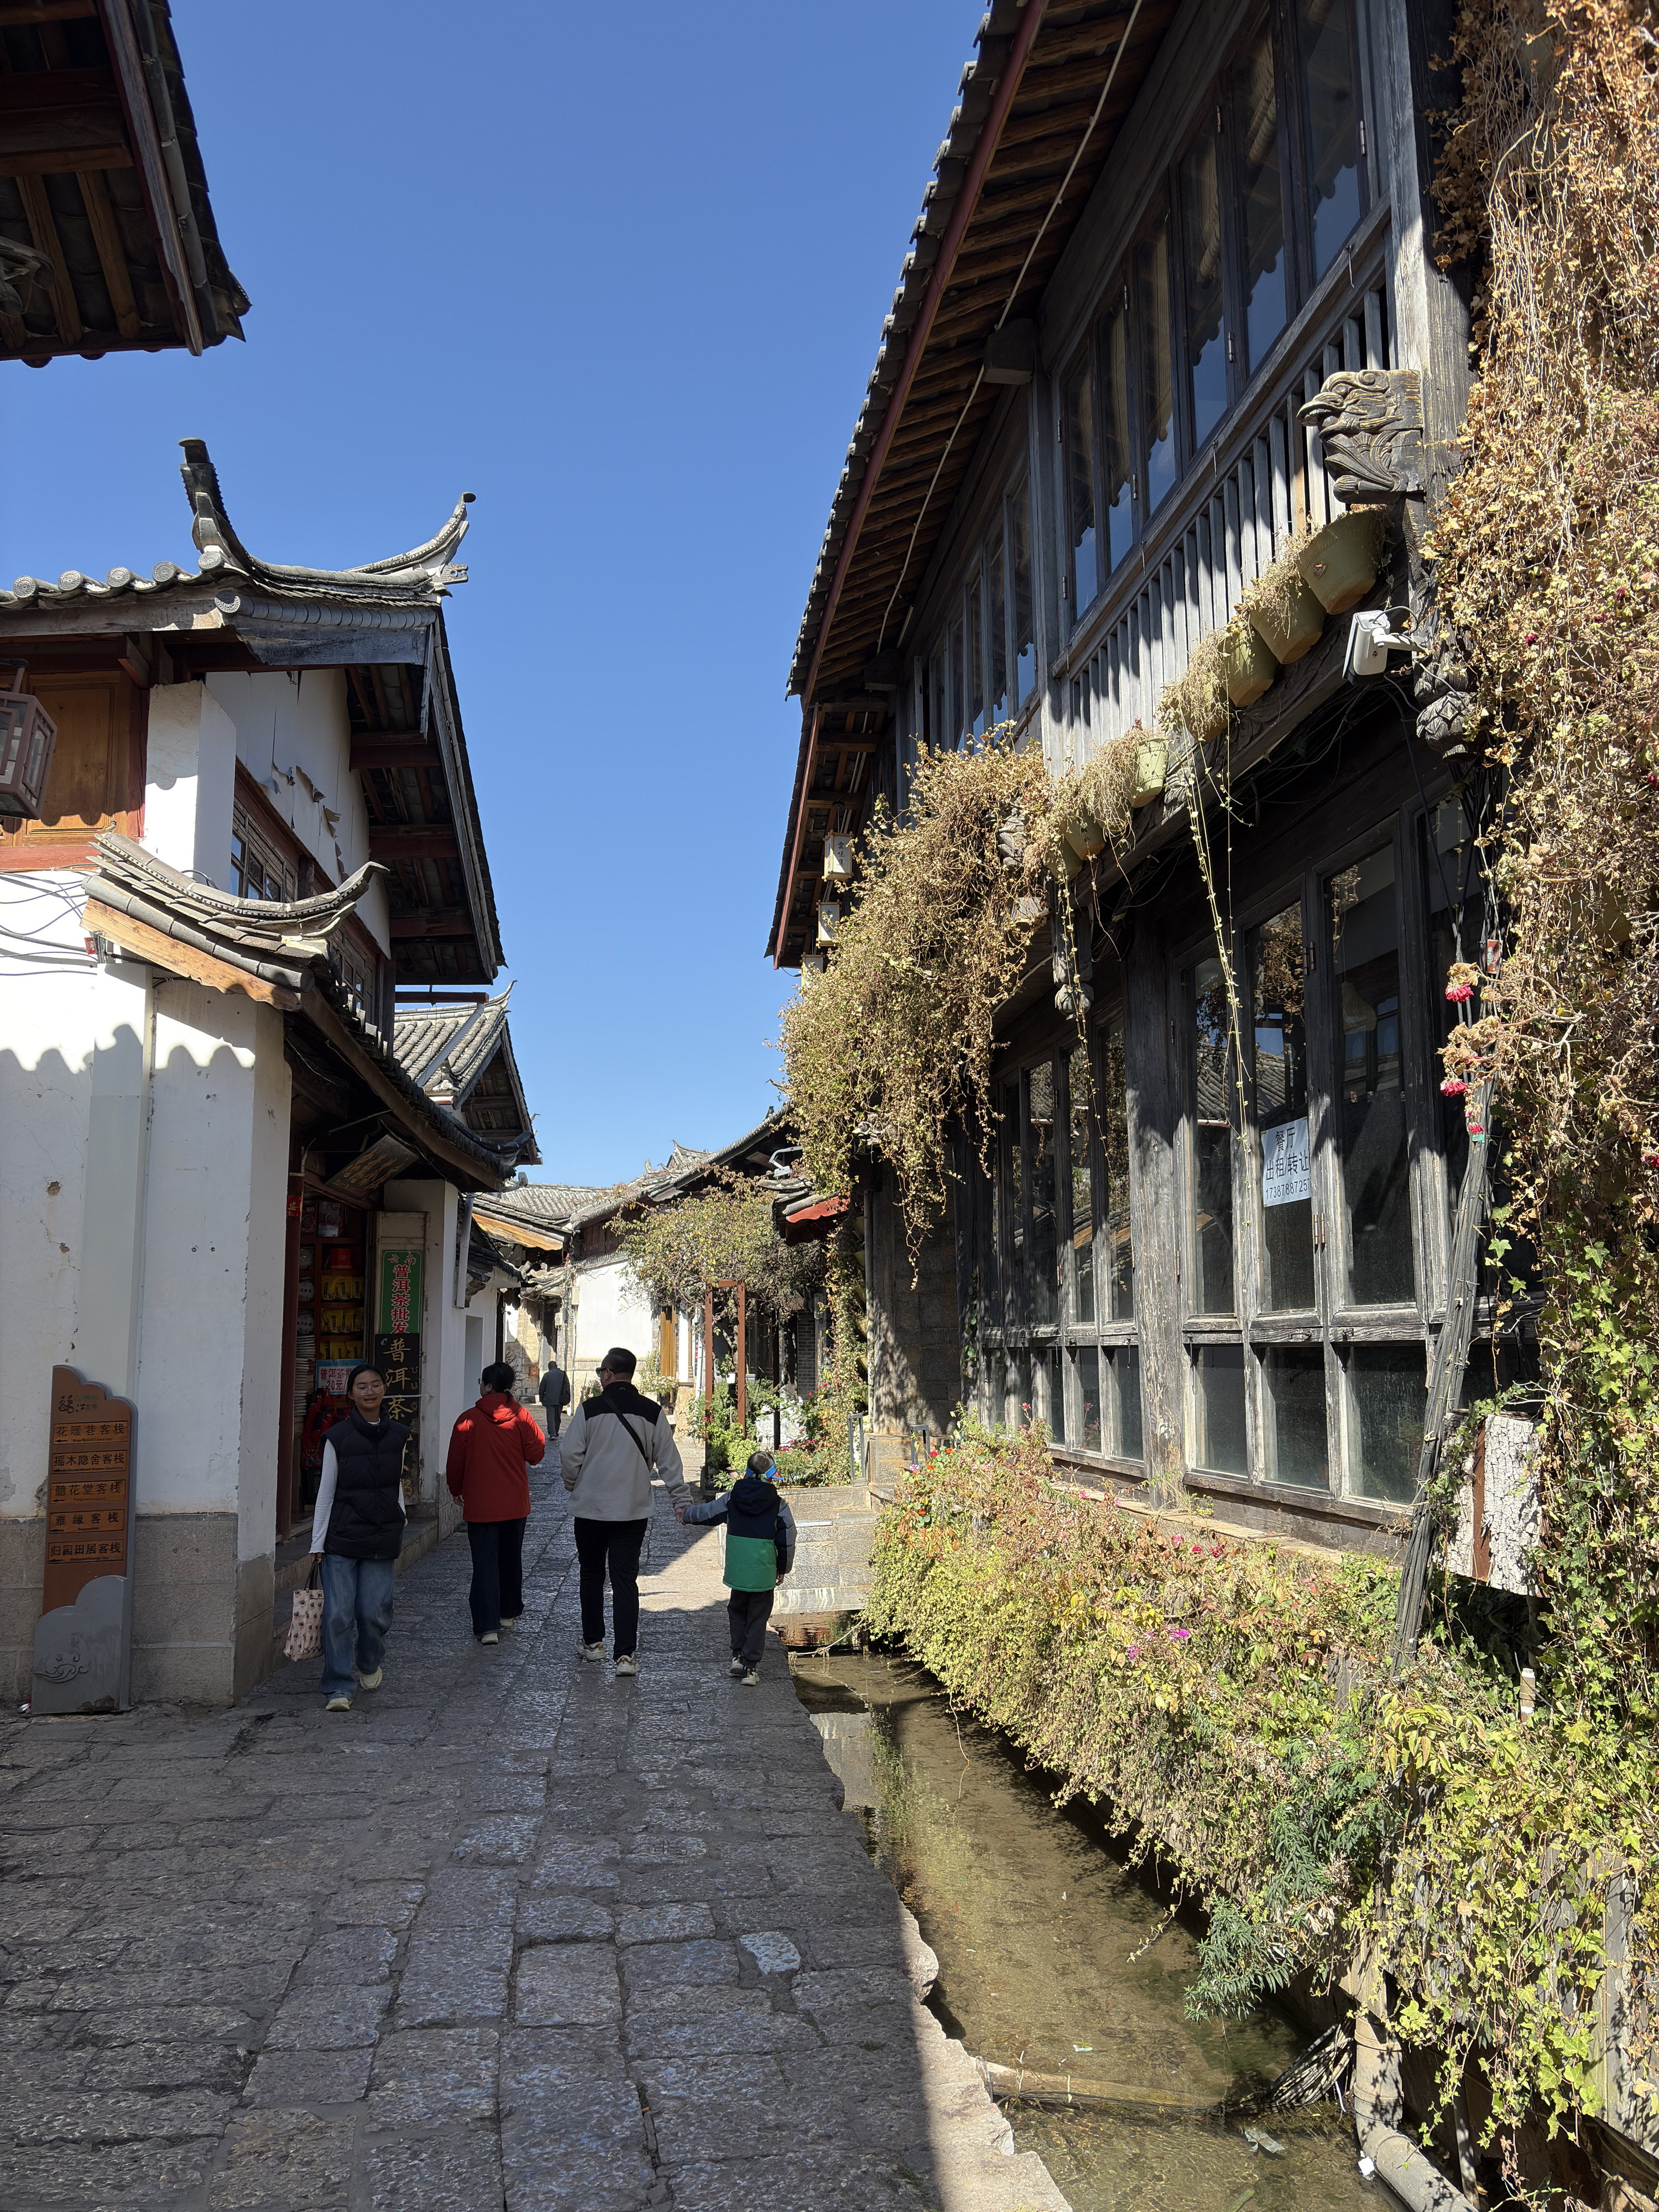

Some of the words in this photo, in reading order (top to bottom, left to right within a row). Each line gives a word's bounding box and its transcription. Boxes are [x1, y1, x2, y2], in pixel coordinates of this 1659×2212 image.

[1275, 1126, 1296, 1152] 餐厅
[1266, 1150, 1309, 1181] 出租/转让
[388, 1250, 416, 1265] 云南
[390, 1264, 411, 1334] 普洱茶批发
[56, 1423, 125, 1437] 花暖巷客栈
[54, 1453, 124, 1467] 摇木隐舍客栈
[55, 1512, 119, 1526] 雅缘客栈
[50, 1542, 121, 1557] 归园田居客栈
